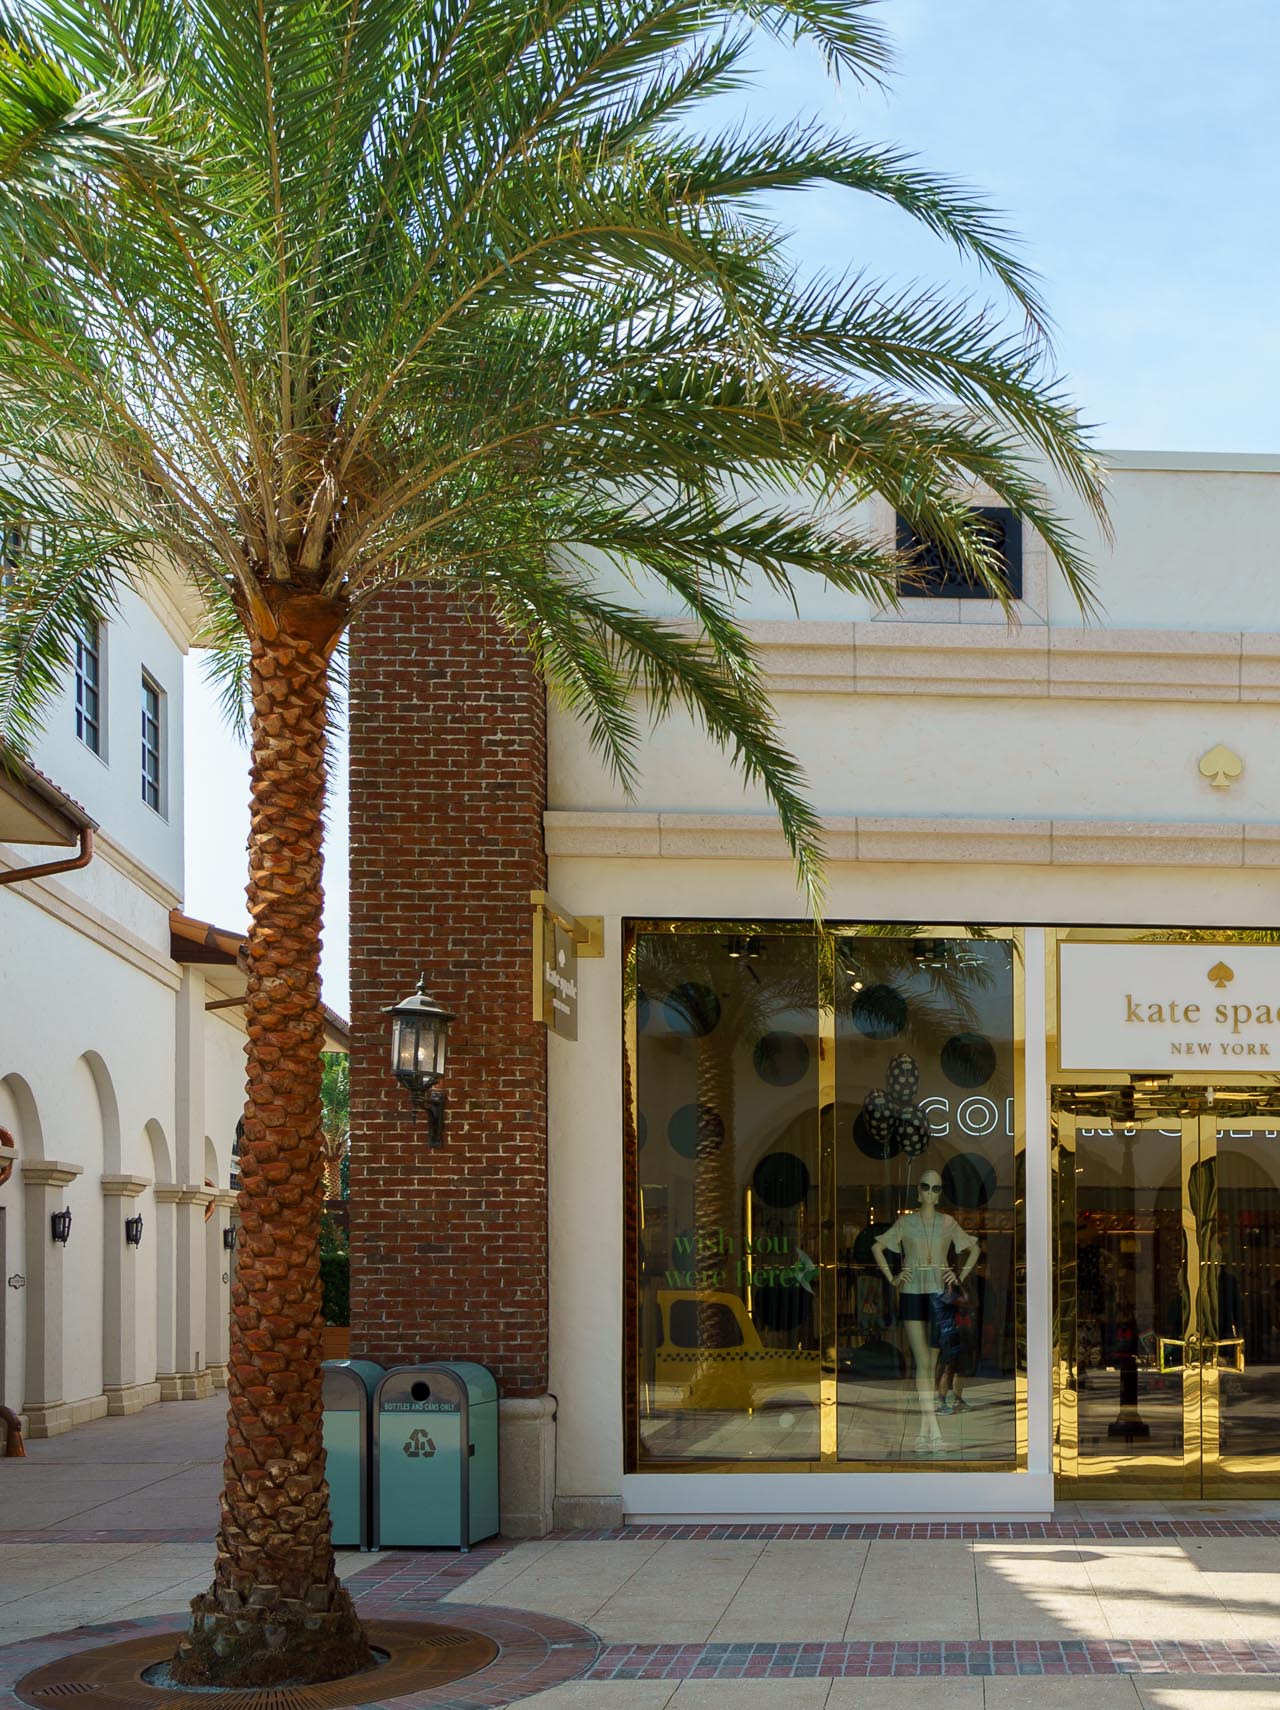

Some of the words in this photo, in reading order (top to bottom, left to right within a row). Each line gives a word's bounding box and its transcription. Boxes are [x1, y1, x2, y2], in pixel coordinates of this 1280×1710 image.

[1125, 994, 1201, 1023] kate
[1170, 1042, 1212, 1055] NEW
[1219, 1043, 1271, 1056] YORK
[384, 1402, 410, 1411] BOTTLES
[411, 1402, 424, 1411] AND
[424, 1402, 439, 1411] CANS
[440, 1402, 456, 1411] ONLY
